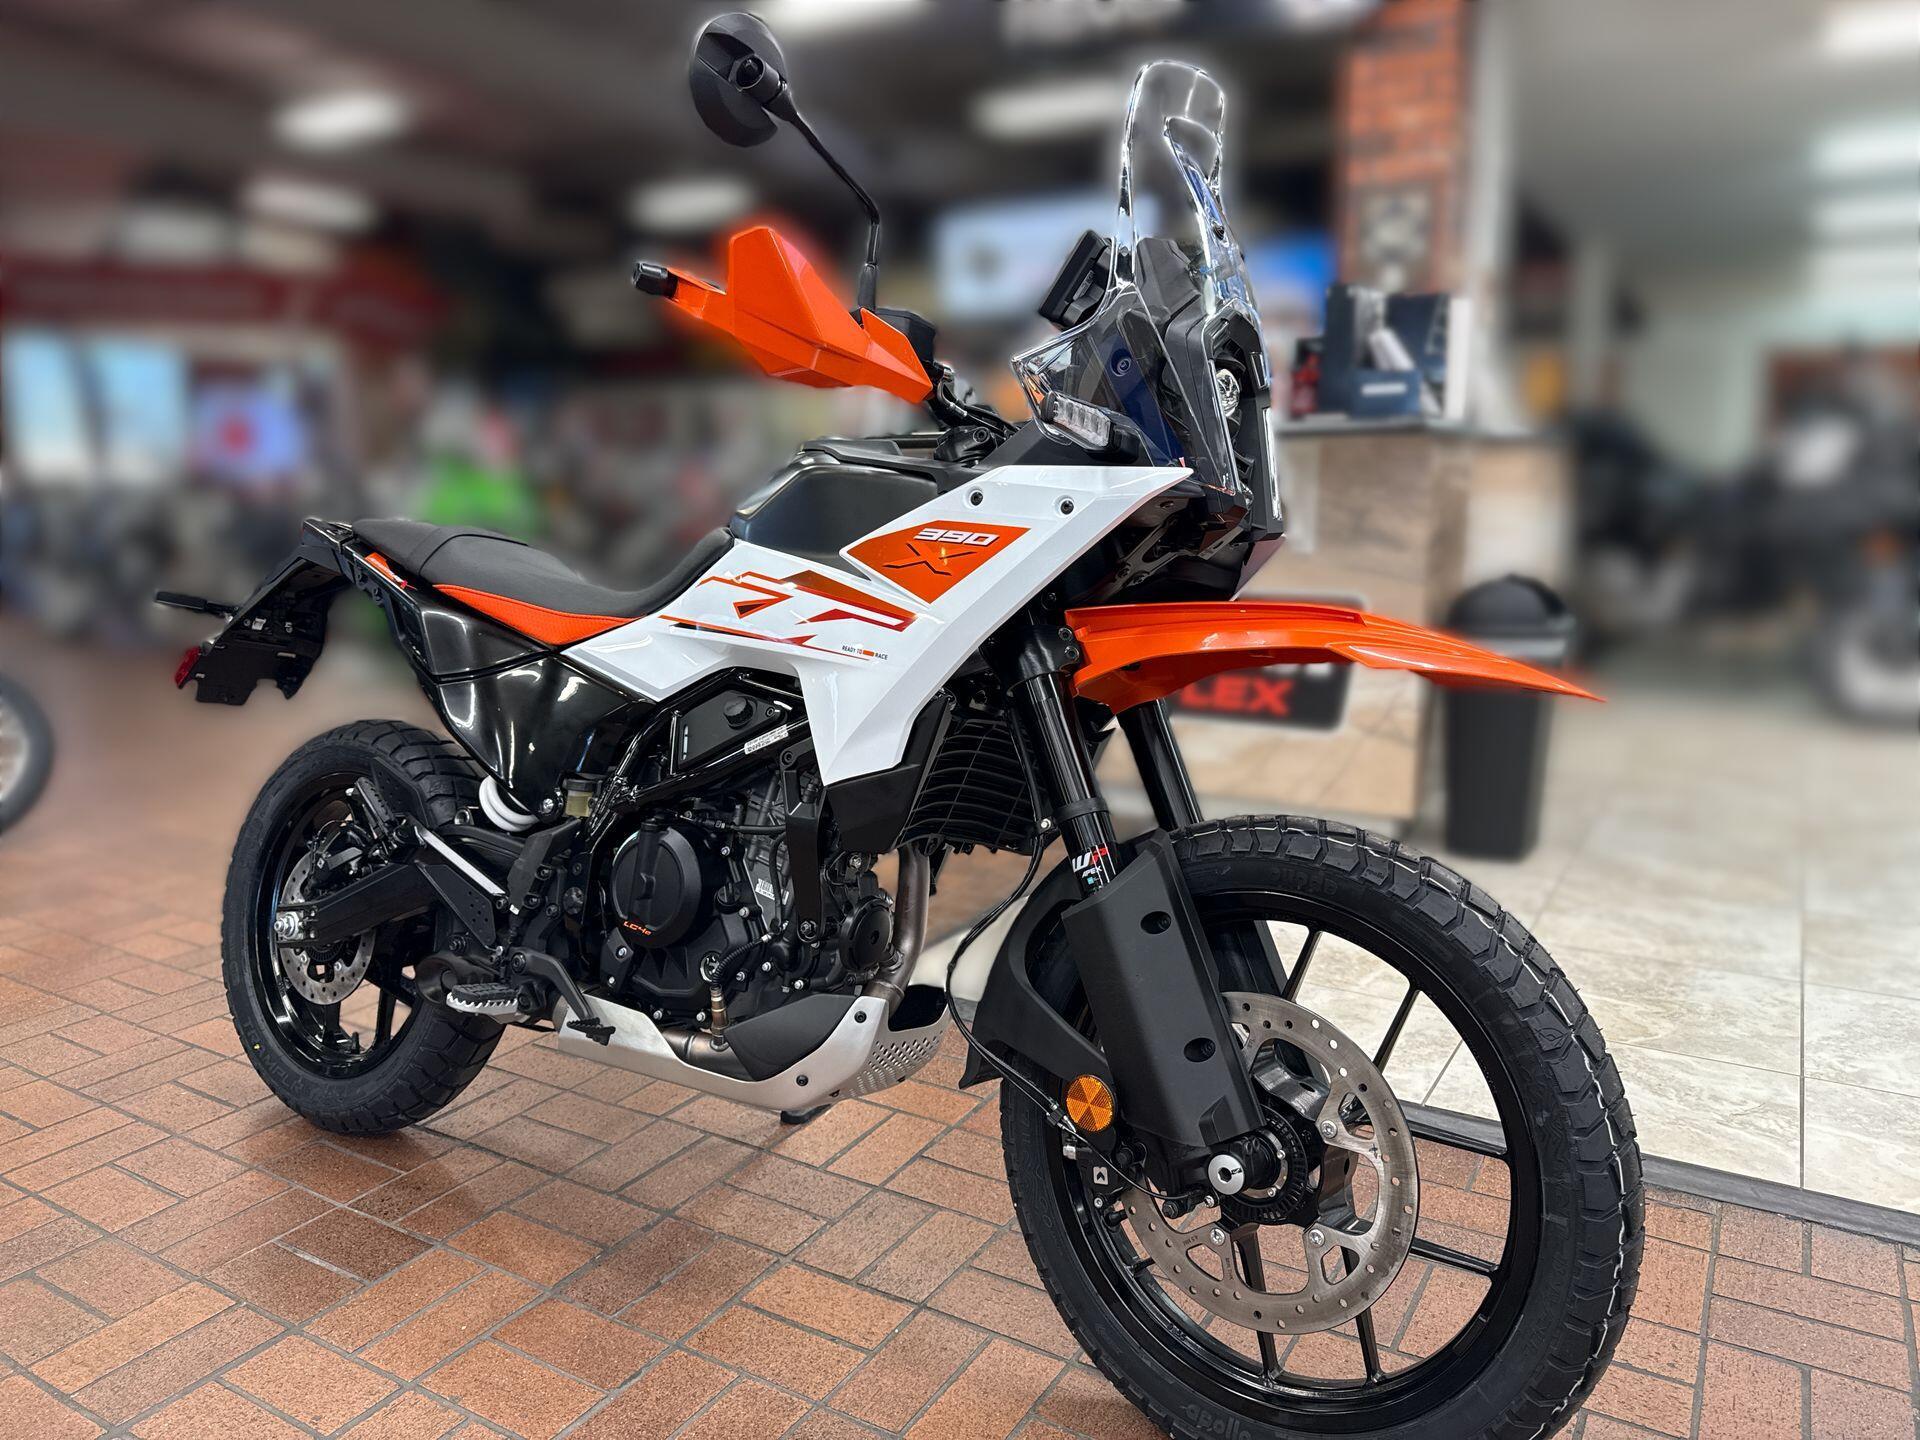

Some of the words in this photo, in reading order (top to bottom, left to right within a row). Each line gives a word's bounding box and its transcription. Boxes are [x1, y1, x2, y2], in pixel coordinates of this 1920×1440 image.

[914, 528, 1000, 546] 390
[842, 645, 856, 653] READY
[875, 652, 889, 661] RACE
[1082, 865, 1103, 879] APEX
